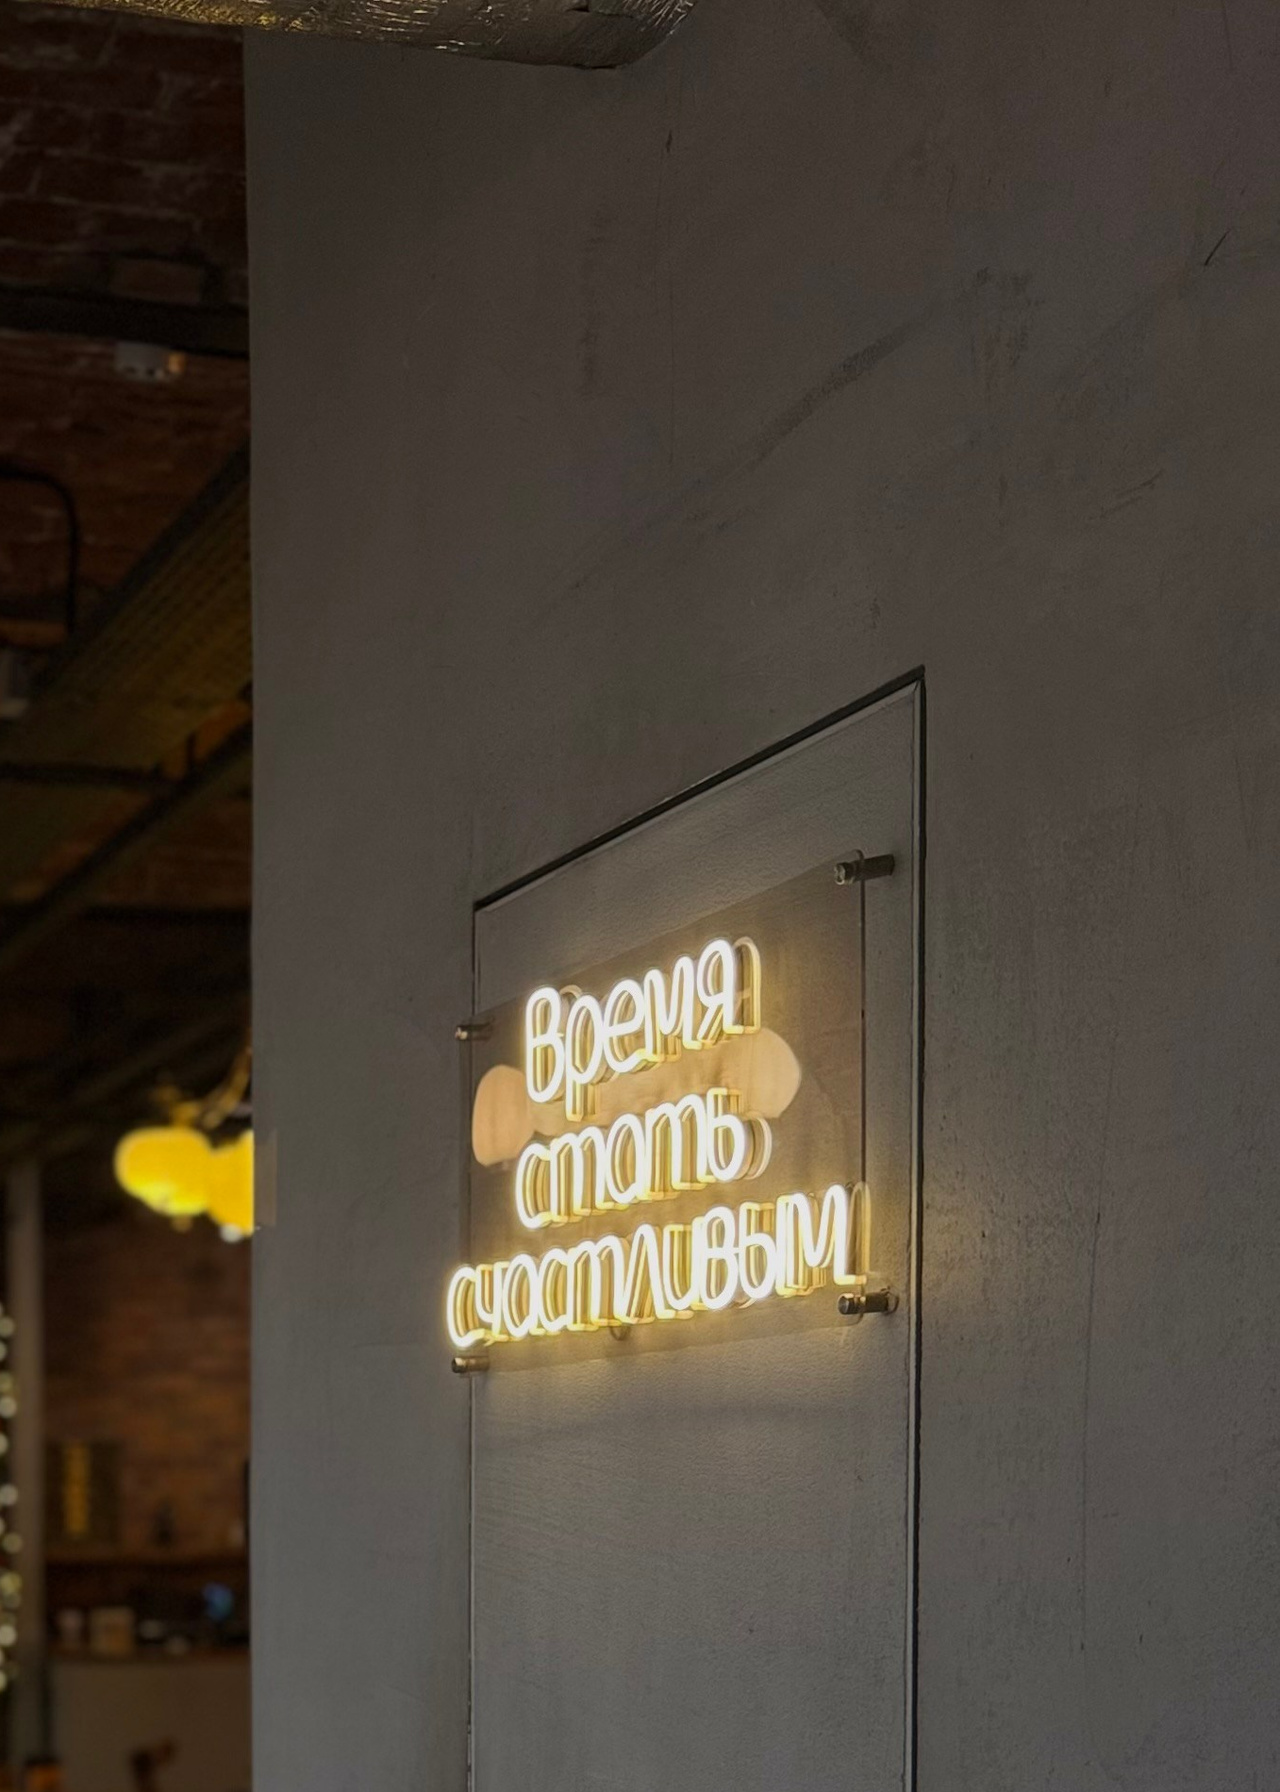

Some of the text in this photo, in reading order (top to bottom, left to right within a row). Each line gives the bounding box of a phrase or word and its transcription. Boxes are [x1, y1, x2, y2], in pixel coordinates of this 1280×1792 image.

[524, 938, 748, 1121] Время
[516, 1087, 752, 1230] стать
[447, 1183, 860, 1349] счастливым
